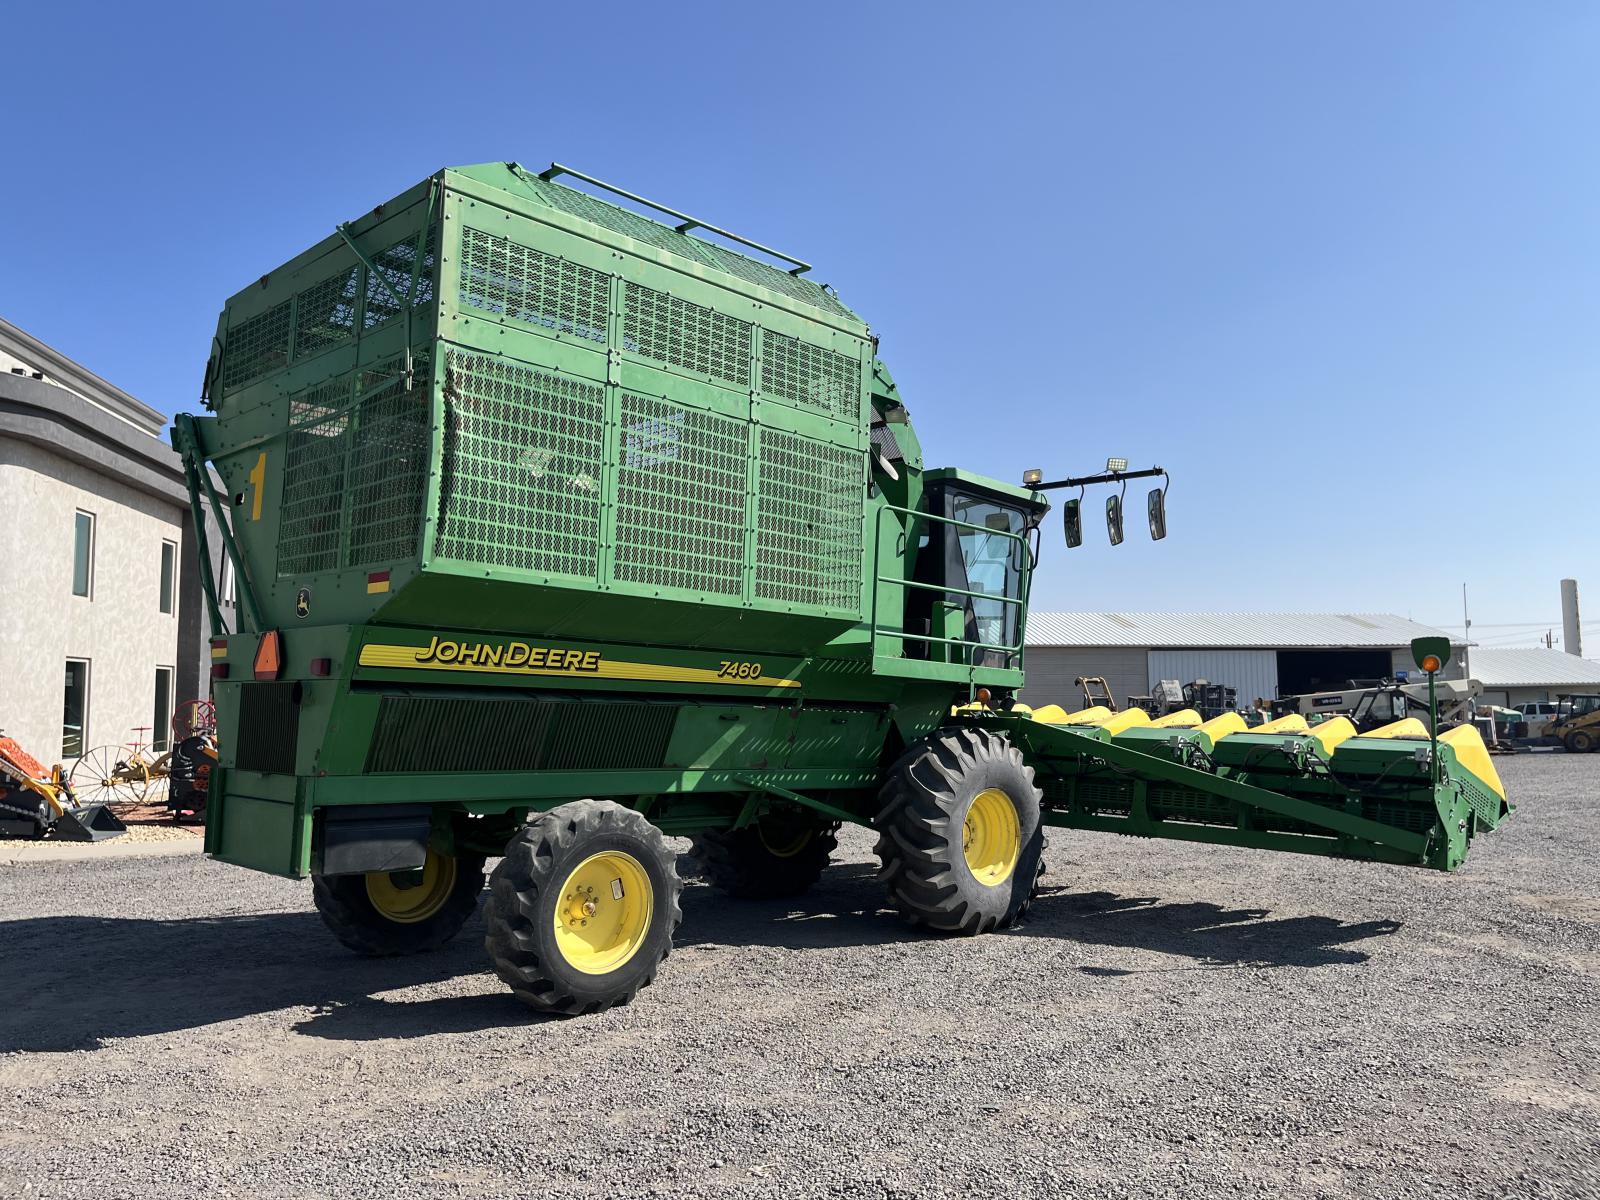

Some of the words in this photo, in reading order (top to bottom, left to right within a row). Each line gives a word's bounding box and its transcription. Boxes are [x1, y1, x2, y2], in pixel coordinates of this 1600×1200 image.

[250, 453, 267, 521] 1
[415, 636, 503, 665] JOHN
[504, 642, 601, 670] DEERE
[718, 660, 762, 678] 7460
